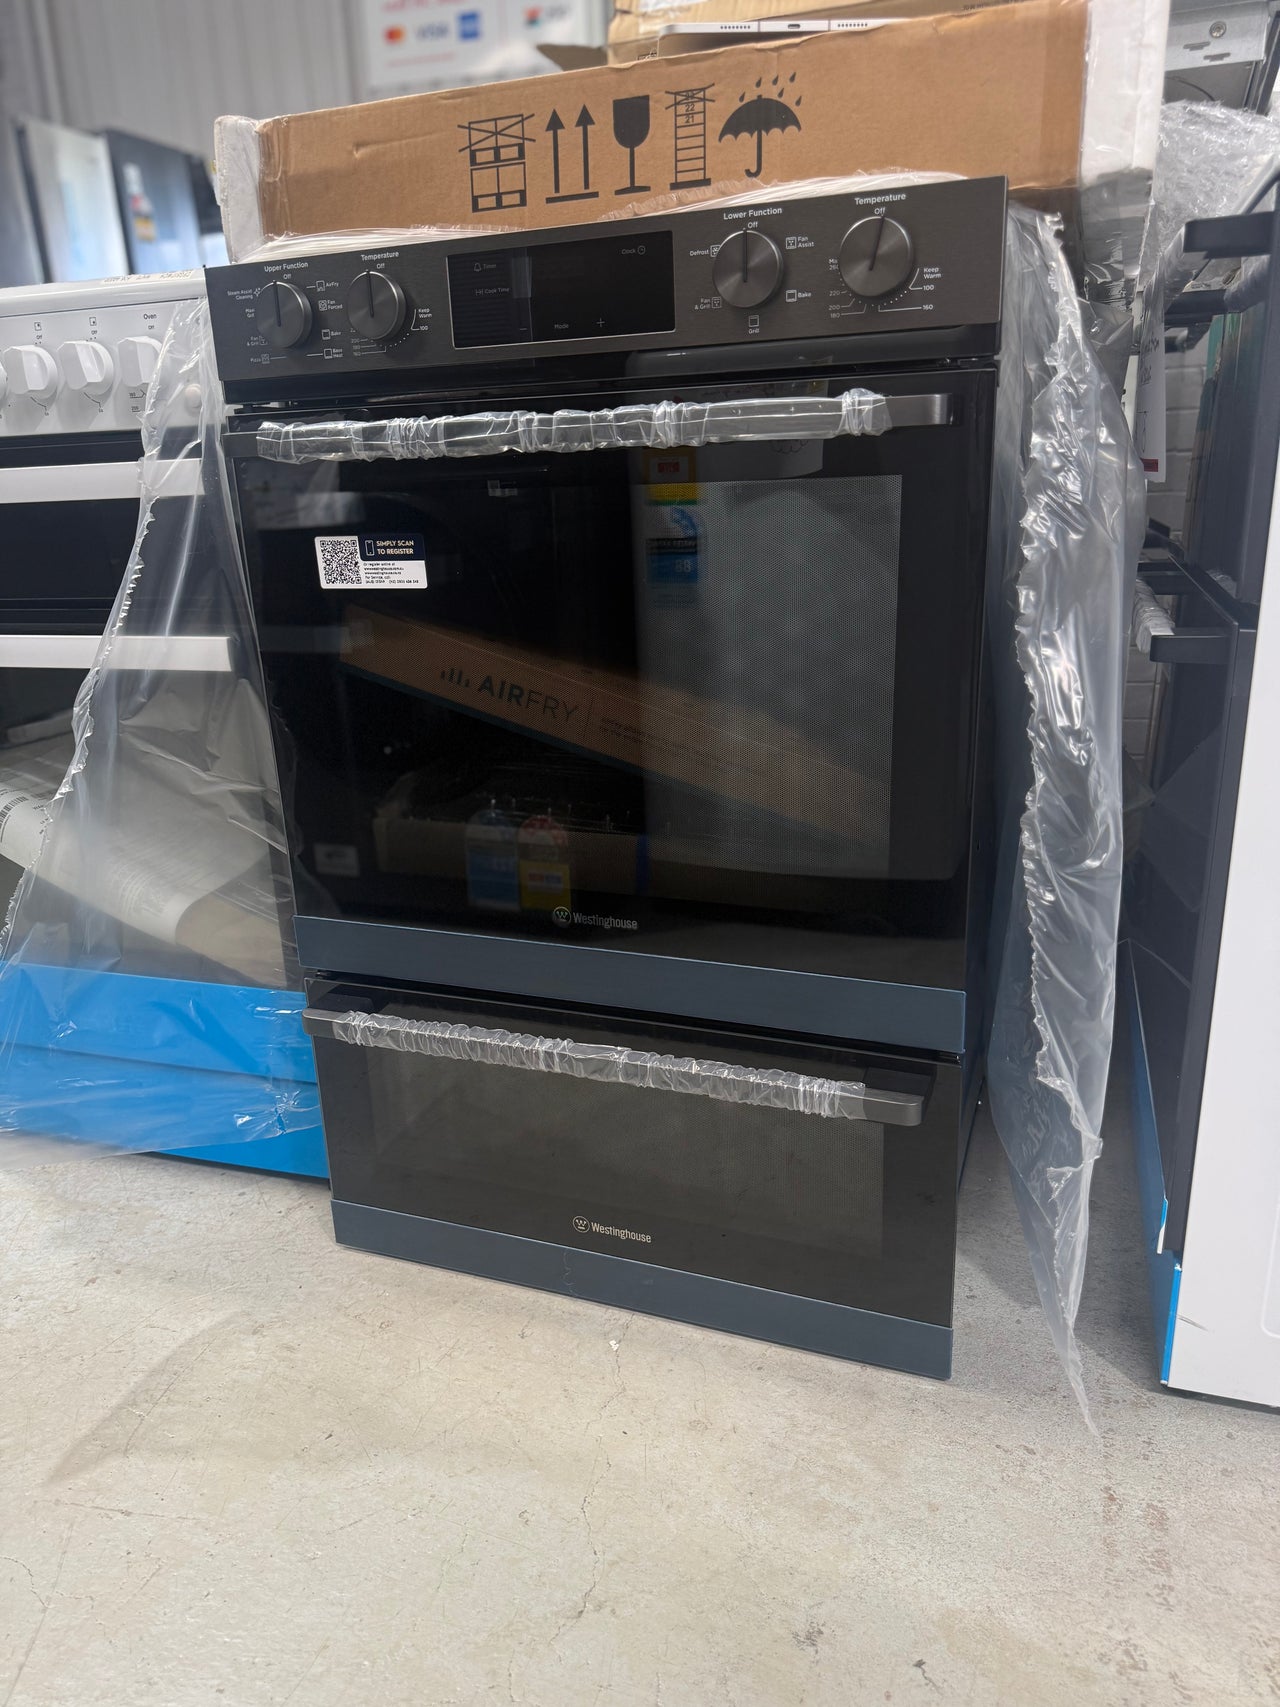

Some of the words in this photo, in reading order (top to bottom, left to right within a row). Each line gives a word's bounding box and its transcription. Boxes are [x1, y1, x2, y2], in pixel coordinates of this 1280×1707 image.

[684, 103, 695, 112] 22
[684, 115, 695, 123] 21
[854, 193, 907, 205] Temperature
[723, 212, 746, 220] Lower
[748, 207, 783, 218] Function
[874, 207, 886, 215] Off
[747, 221, 759, 229] Off
[361, 251, 399, 260] Temperature
[689, 249, 709, 257] Defrost
[264, 265, 282, 273] Upper
[283, 261, 309, 269] Function
[497, 286, 510, 294] Time
[478, 674, 579, 724] AIRFRY
[573, 912, 638, 930] Westinghouse
[590, 1221, 653, 1244] Westinghouse
